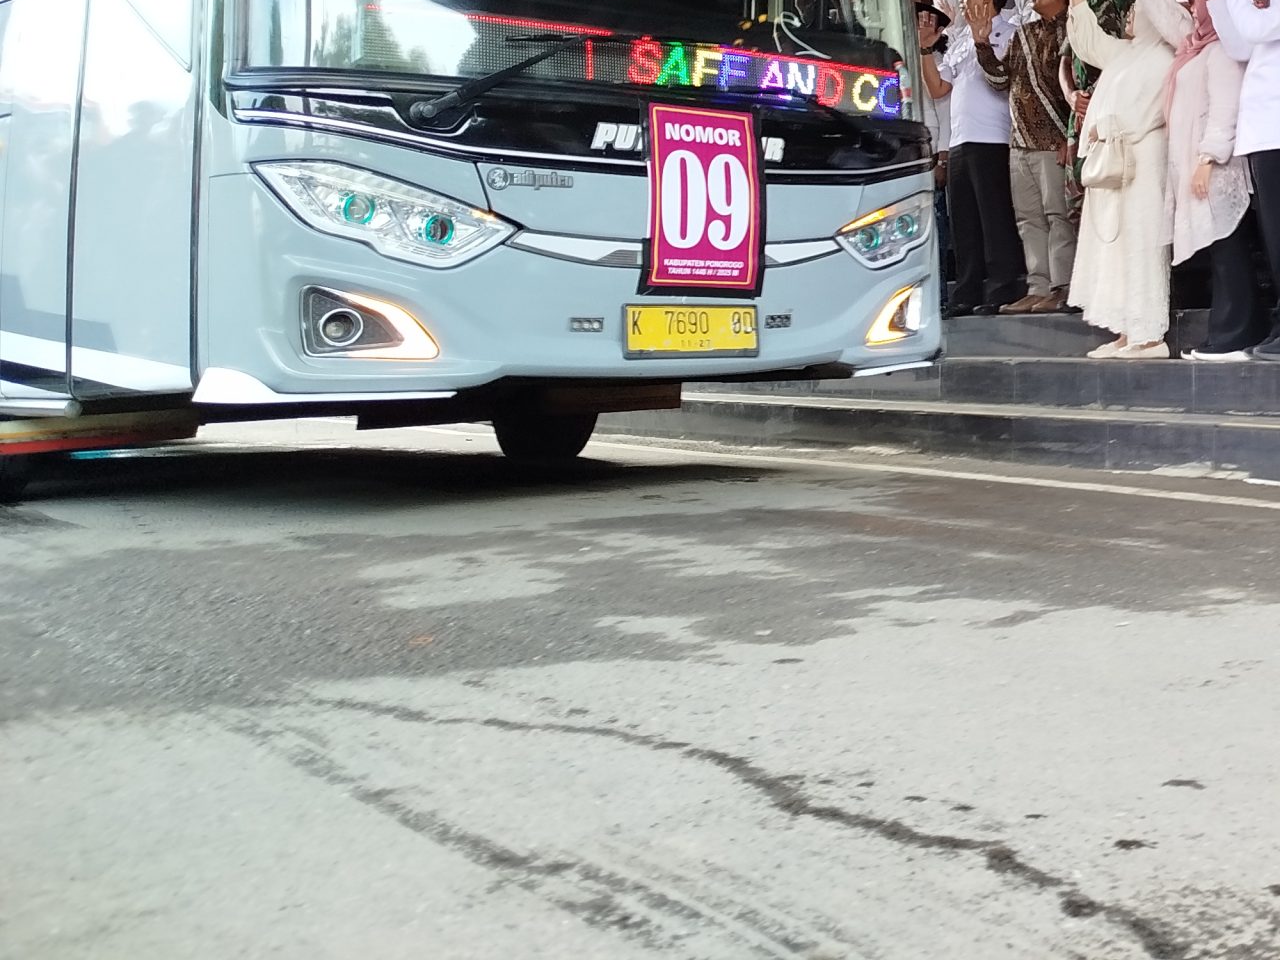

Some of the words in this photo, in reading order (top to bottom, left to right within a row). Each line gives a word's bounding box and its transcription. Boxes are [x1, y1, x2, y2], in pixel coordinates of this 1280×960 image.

[759, 60, 844, 107] AND
[664, 123, 741, 147] NOMOR
[661, 150, 750, 250] 09
[663, 258, 705, 268] KABUPATEN
[705, 260, 745, 269] PONOROGO
[631, 310, 642, 336] K
[664, 310, 709, 335] 7690
